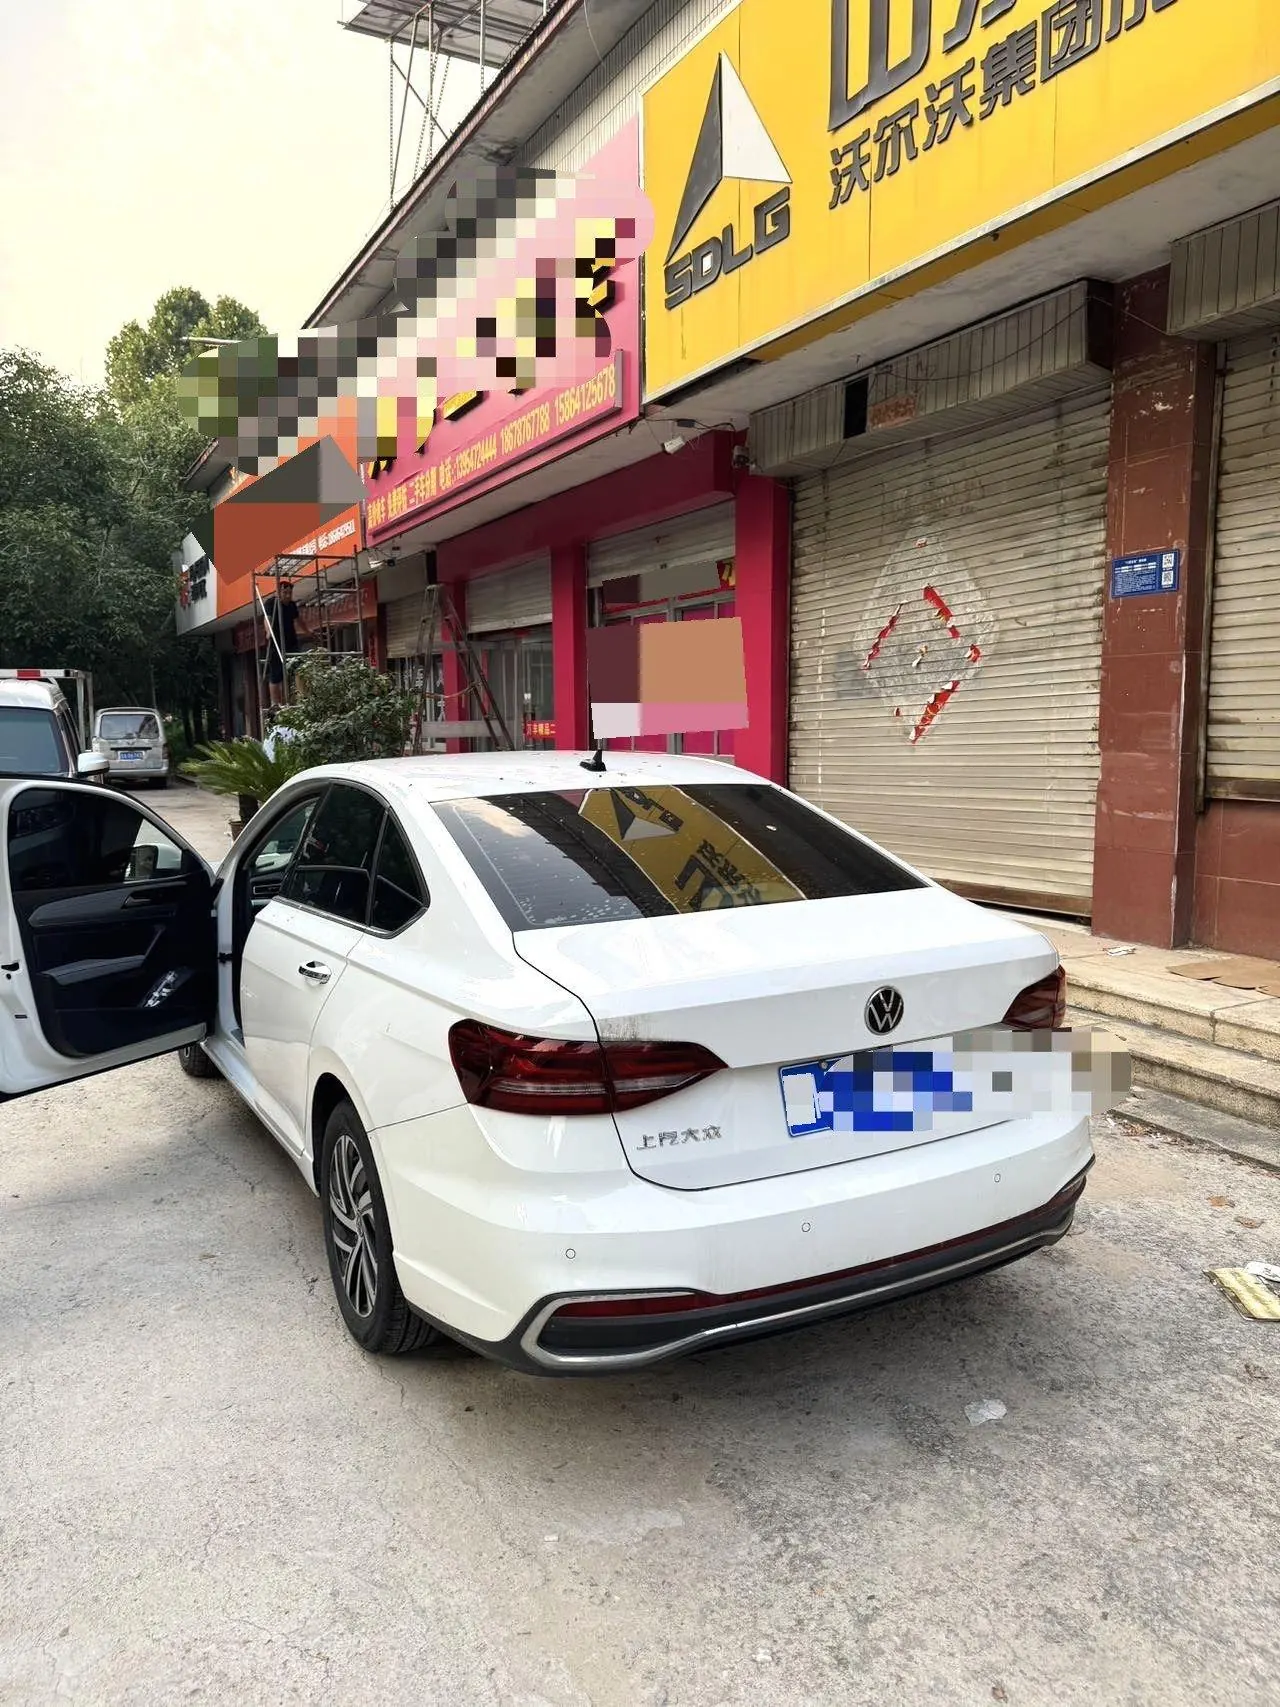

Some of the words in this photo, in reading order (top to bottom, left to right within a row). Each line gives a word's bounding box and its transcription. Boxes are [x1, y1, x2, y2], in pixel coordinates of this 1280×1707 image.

[828, 0, 1016, 132] 山
[664, 186, 790, 309] SDLG
[636, 1124, 721, 1151] 上汽大众
